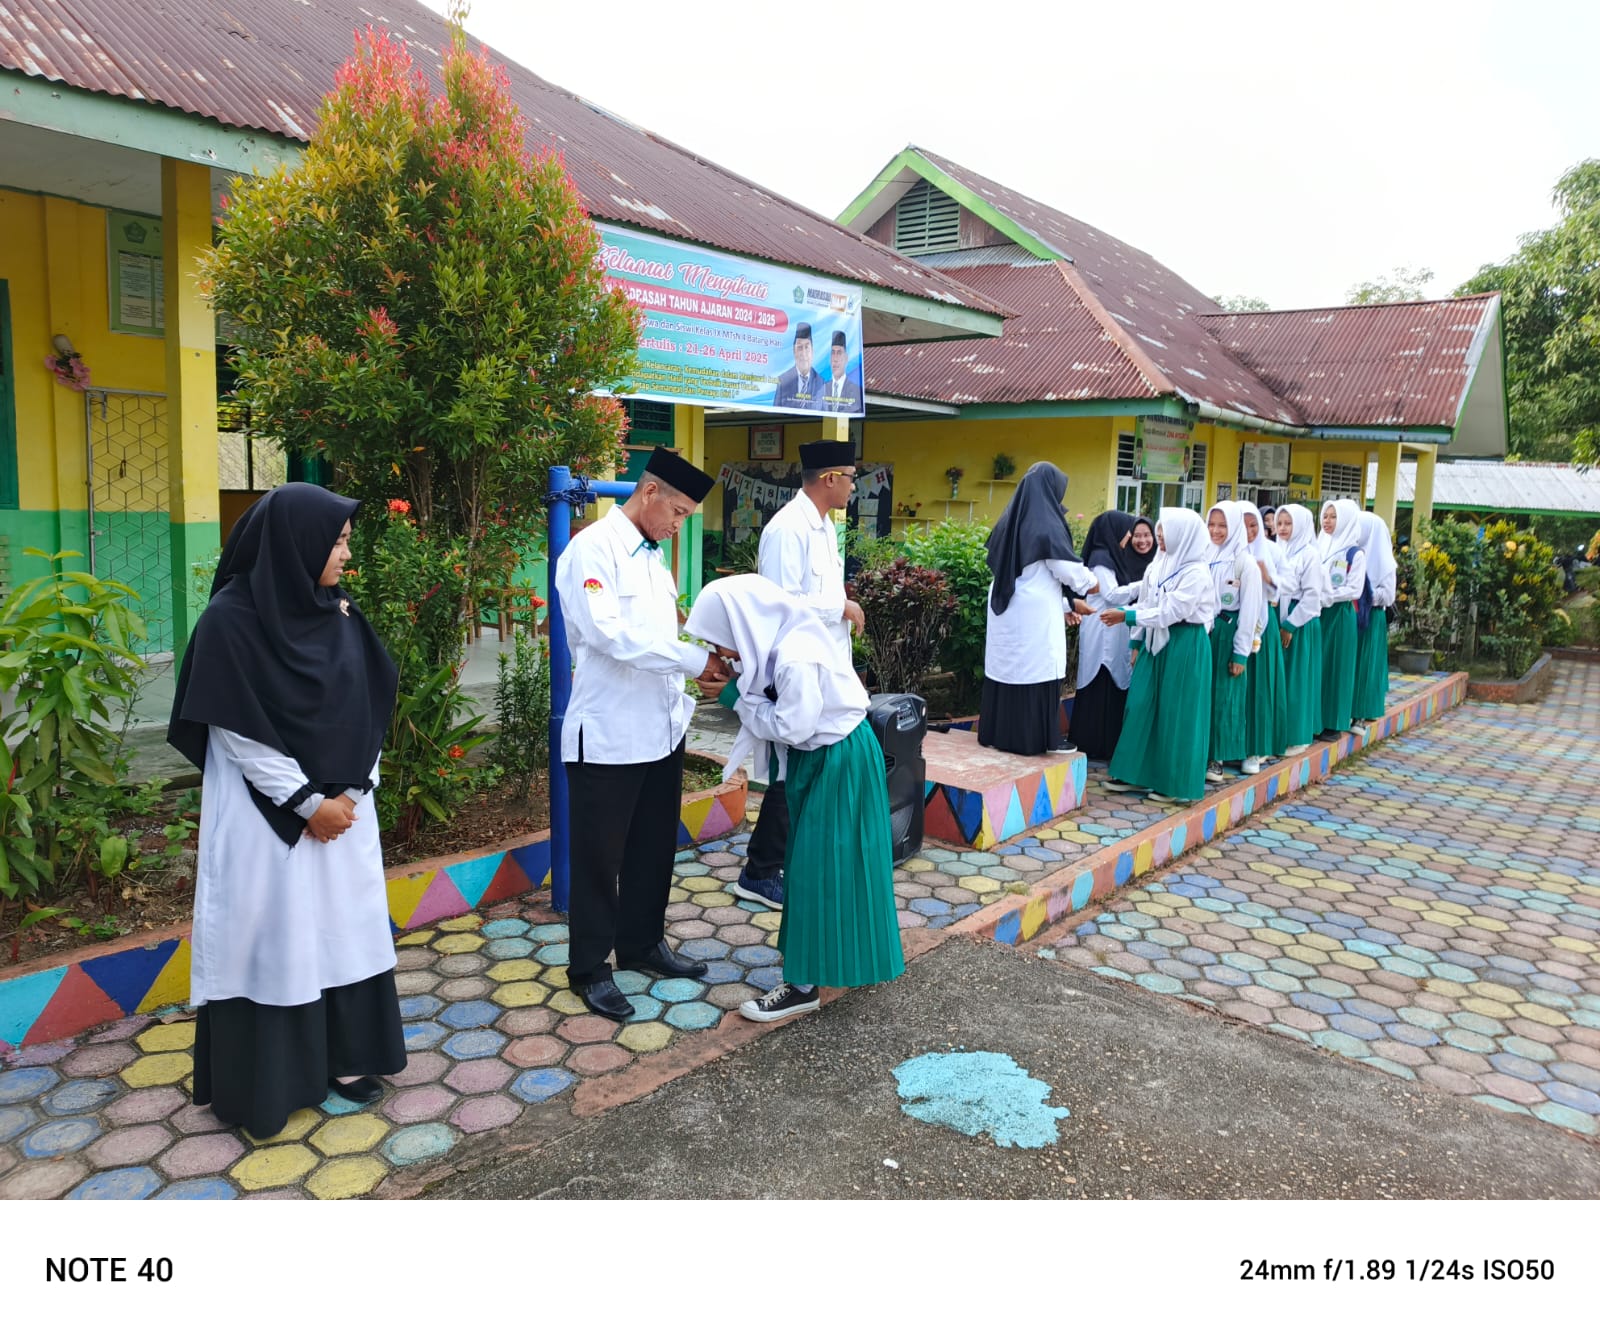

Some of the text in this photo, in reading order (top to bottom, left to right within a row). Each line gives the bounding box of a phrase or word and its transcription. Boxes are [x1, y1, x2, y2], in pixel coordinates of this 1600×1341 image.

[679, 263, 768, 300] Mengikuti
[668, 295, 698, 312] TAHUN
[701, 301, 733, 319] AJARAN
[734, 307, 753, 322] 2024
[758, 312, 776, 327] 2025
[660, 320, 673, 330] dan
[696, 326, 713, 336] Kelas
[638, 337, 676, 352] ertulis
[686, 343, 716, 357] 21-26
[718, 346, 742, 361] April
[745, 351, 768, 364] 2025
